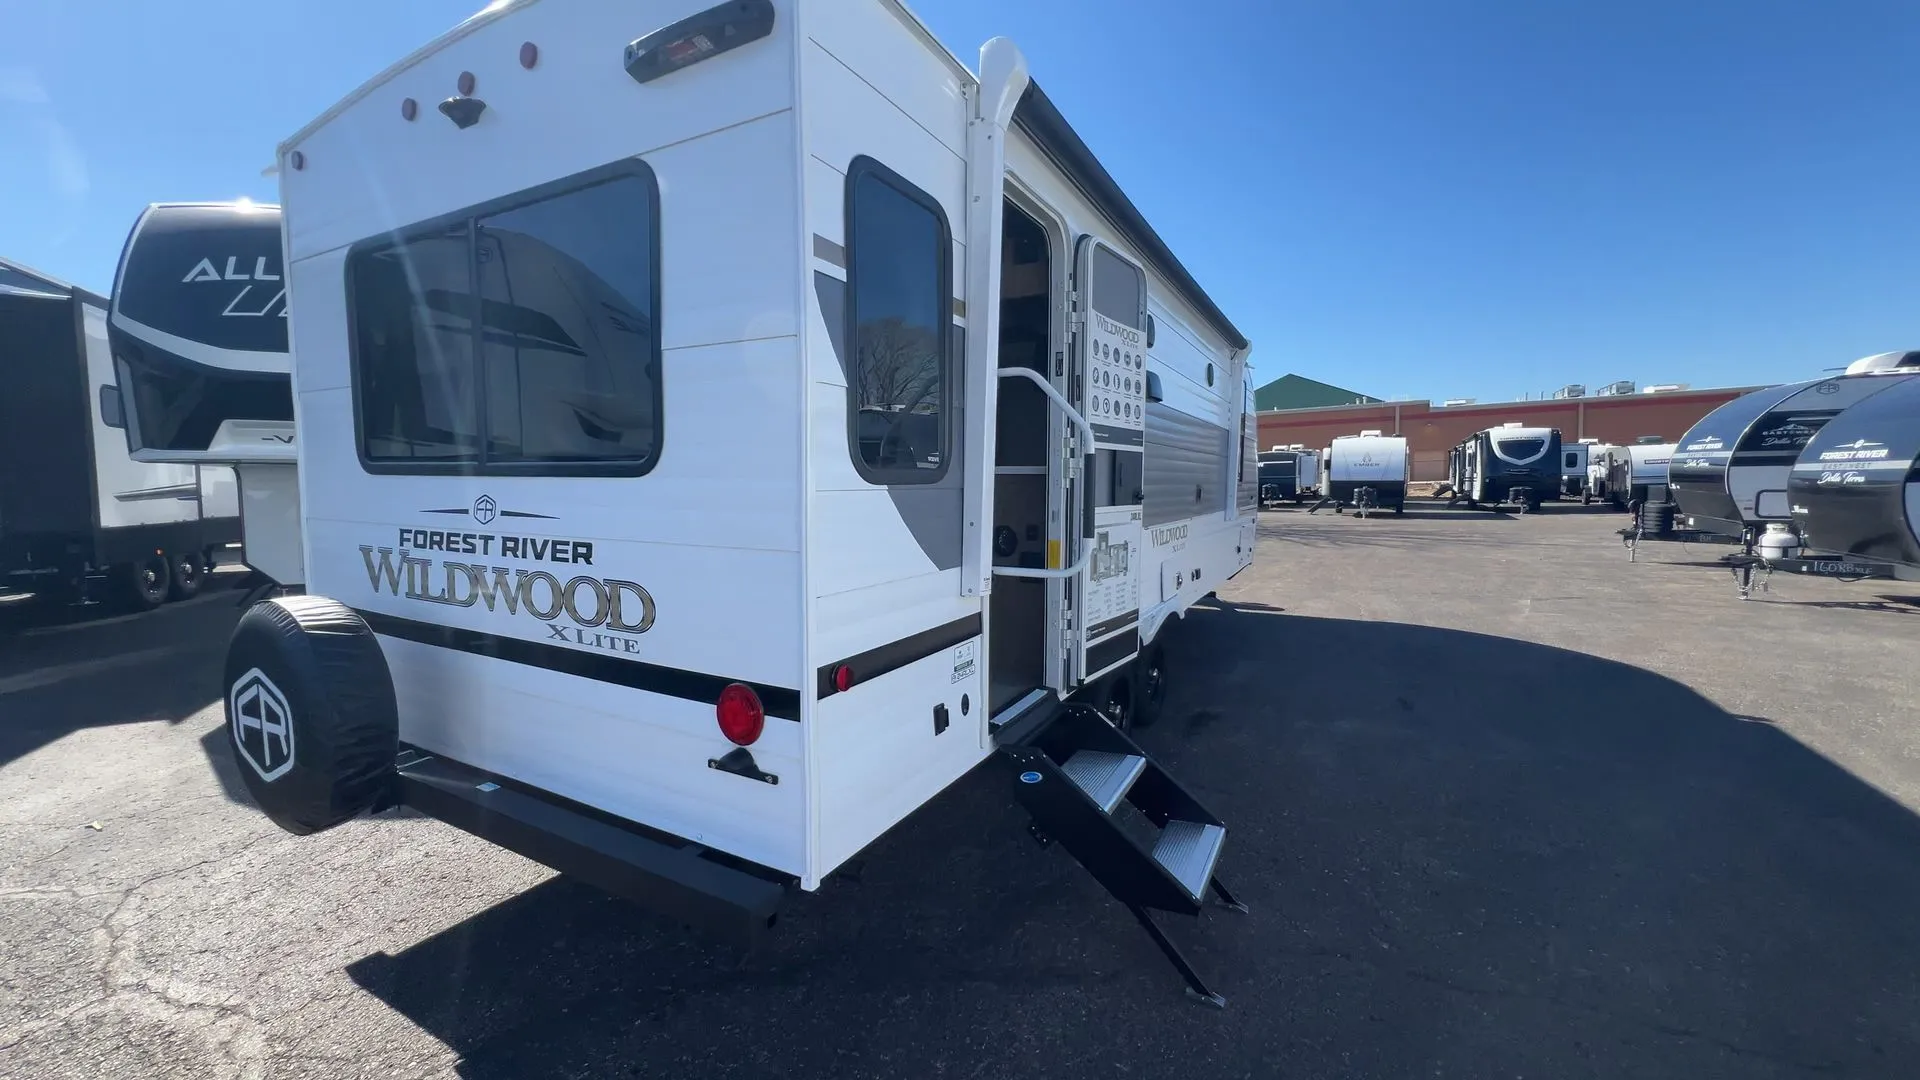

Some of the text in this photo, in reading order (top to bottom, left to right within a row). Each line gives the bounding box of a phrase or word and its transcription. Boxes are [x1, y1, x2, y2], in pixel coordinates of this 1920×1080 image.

[1096, 314, 1139, 344] WILDWOOD
[1820, 449, 1889, 460] FOREST RIVER
[399, 528, 593, 565] FOREST RIVER
[1150, 524, 1188, 549] WILDWOOD
[359, 544, 656, 634] WILDWOOD
